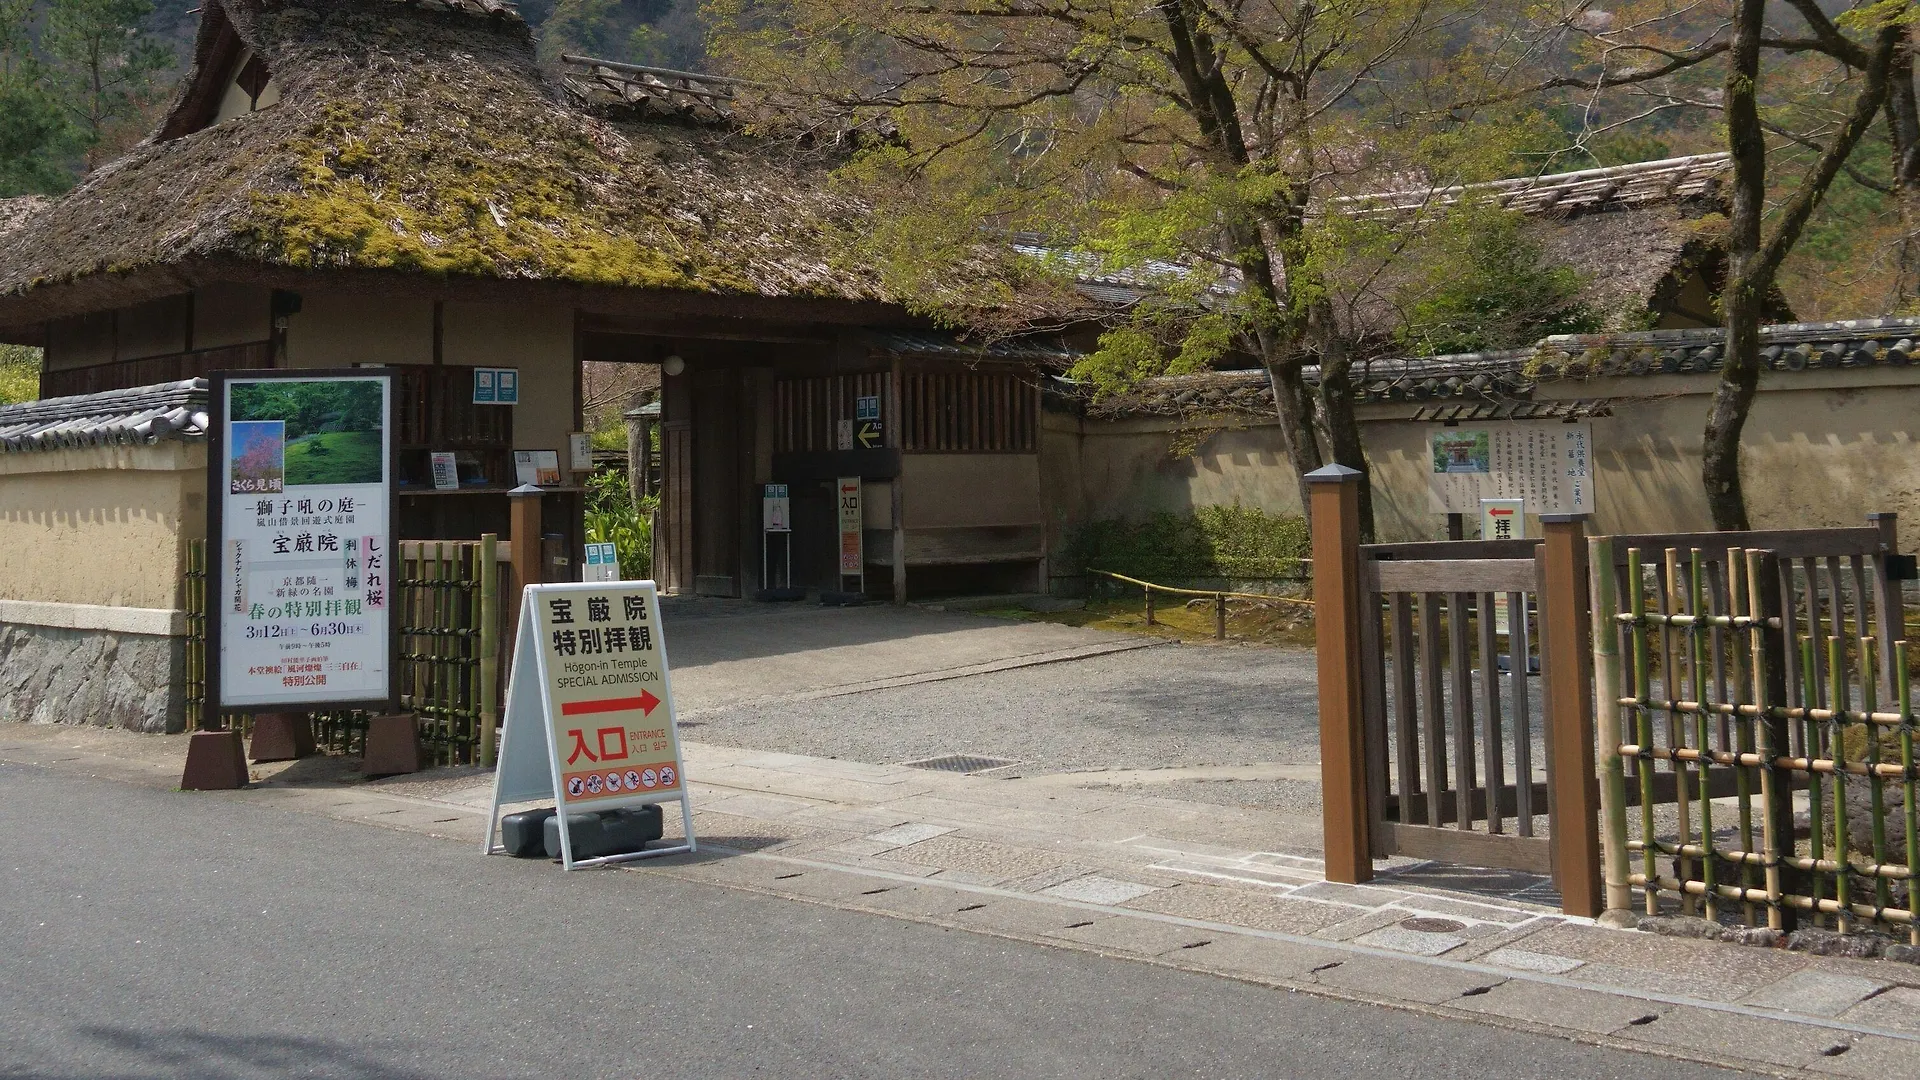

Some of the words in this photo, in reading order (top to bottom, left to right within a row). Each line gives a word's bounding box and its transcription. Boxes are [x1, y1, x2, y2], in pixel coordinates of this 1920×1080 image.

[1566, 432, 1577, 476] 新墓地
[1576, 431, 1586, 477] 永代供養堂
[232, 478, 282, 492] さくら見頃
[841, 497, 857, 509] 入口
[257, 516, 355, 527] 嵐山借景回遊式庭園
[1495, 519, 1511, 540] 拝
[272, 534, 338, 554] 宝厳院
[345, 539, 358, 588] 利休梅
[365, 537, 384, 606] しだれ桜
[248, 599, 362, 620] 春の特別拝観
[549, 596, 647, 624] 宝厳院
[552, 626, 653, 657] 特別拝観
[612, 658, 647, 670] Temple
[283, 675, 326, 686] 特別公開
[558, 676, 598, 688] SPECIAL
[601, 672, 658, 685] ADMISSION
[630, 729, 665, 741] ENTRANCE
[567, 727, 629, 766] 入口
[631, 744, 647, 754] 入口
[653, 740, 668, 751] 입구
